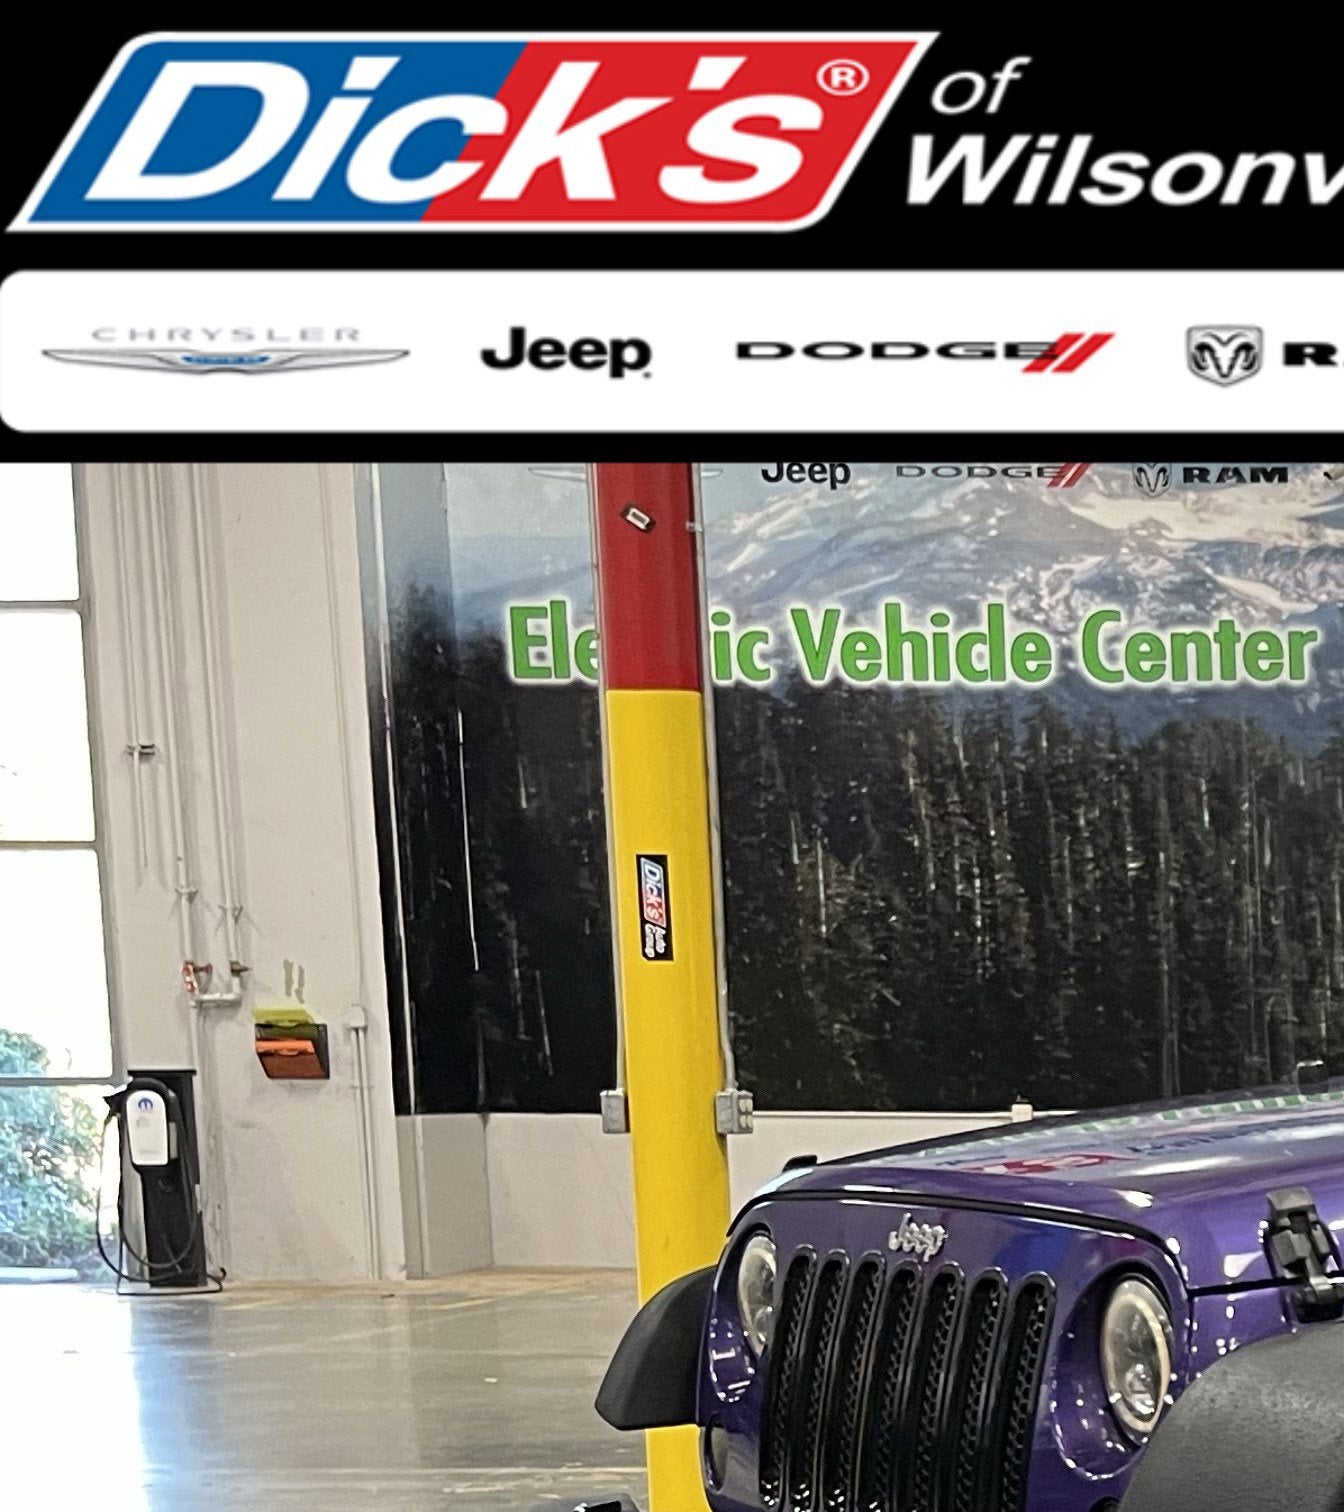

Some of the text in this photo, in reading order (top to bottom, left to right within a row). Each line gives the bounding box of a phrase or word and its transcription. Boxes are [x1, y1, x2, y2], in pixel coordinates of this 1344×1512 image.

[761, 462, 851, 490] Jeep
[895, 465, 1070, 480] DODGE
[1181, 465, 1290, 484] RAM
[510, 601, 1318, 683] Eleic Vehicle Center
[888, 1212, 949, 1262] Jeep
